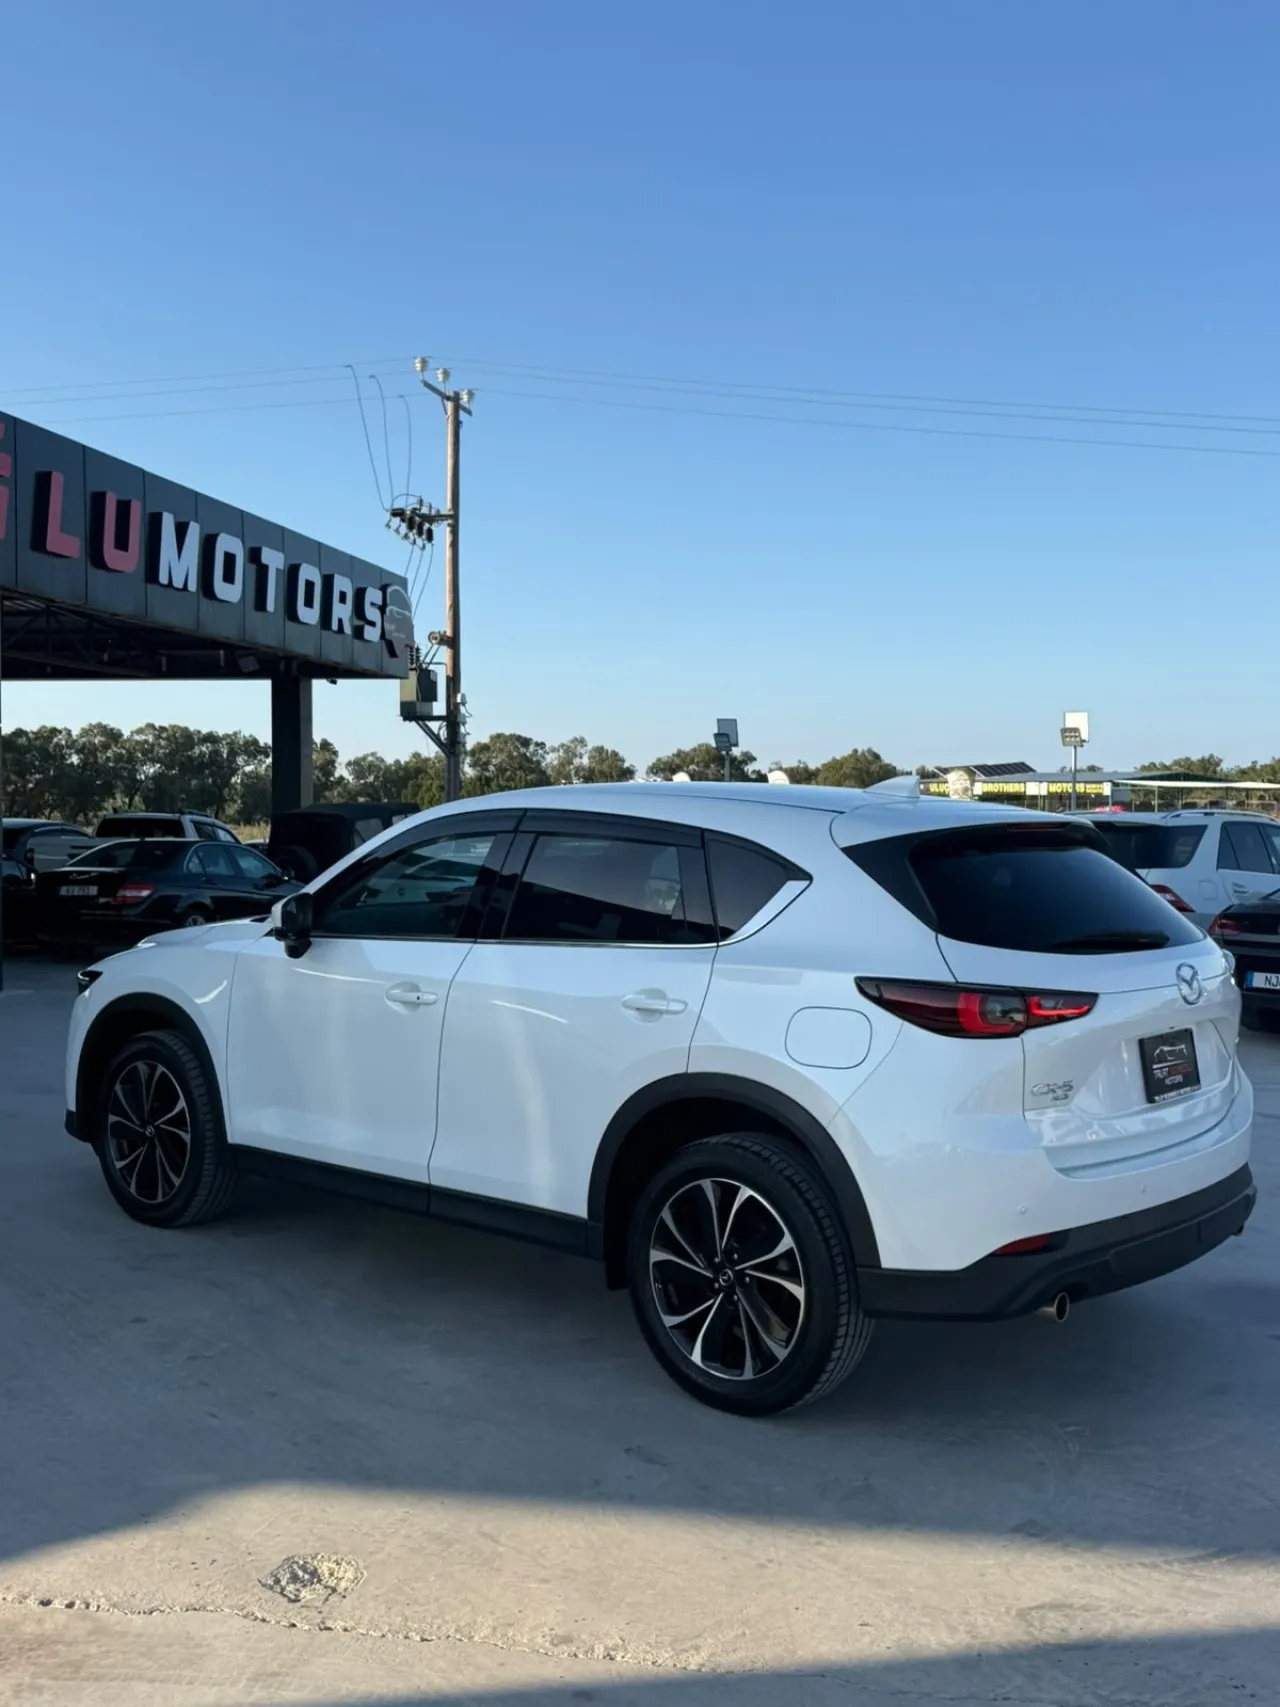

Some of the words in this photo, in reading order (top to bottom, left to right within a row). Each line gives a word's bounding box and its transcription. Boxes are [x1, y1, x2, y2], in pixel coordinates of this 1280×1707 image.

[0, 421, 141, 574] LU
[153, 511, 383, 643] MOTORS
[983, 782, 1025, 792] BROTHERS
[1264, 974, 1280, 988] NJ
[1030, 1079, 1074, 1093] CX-5
